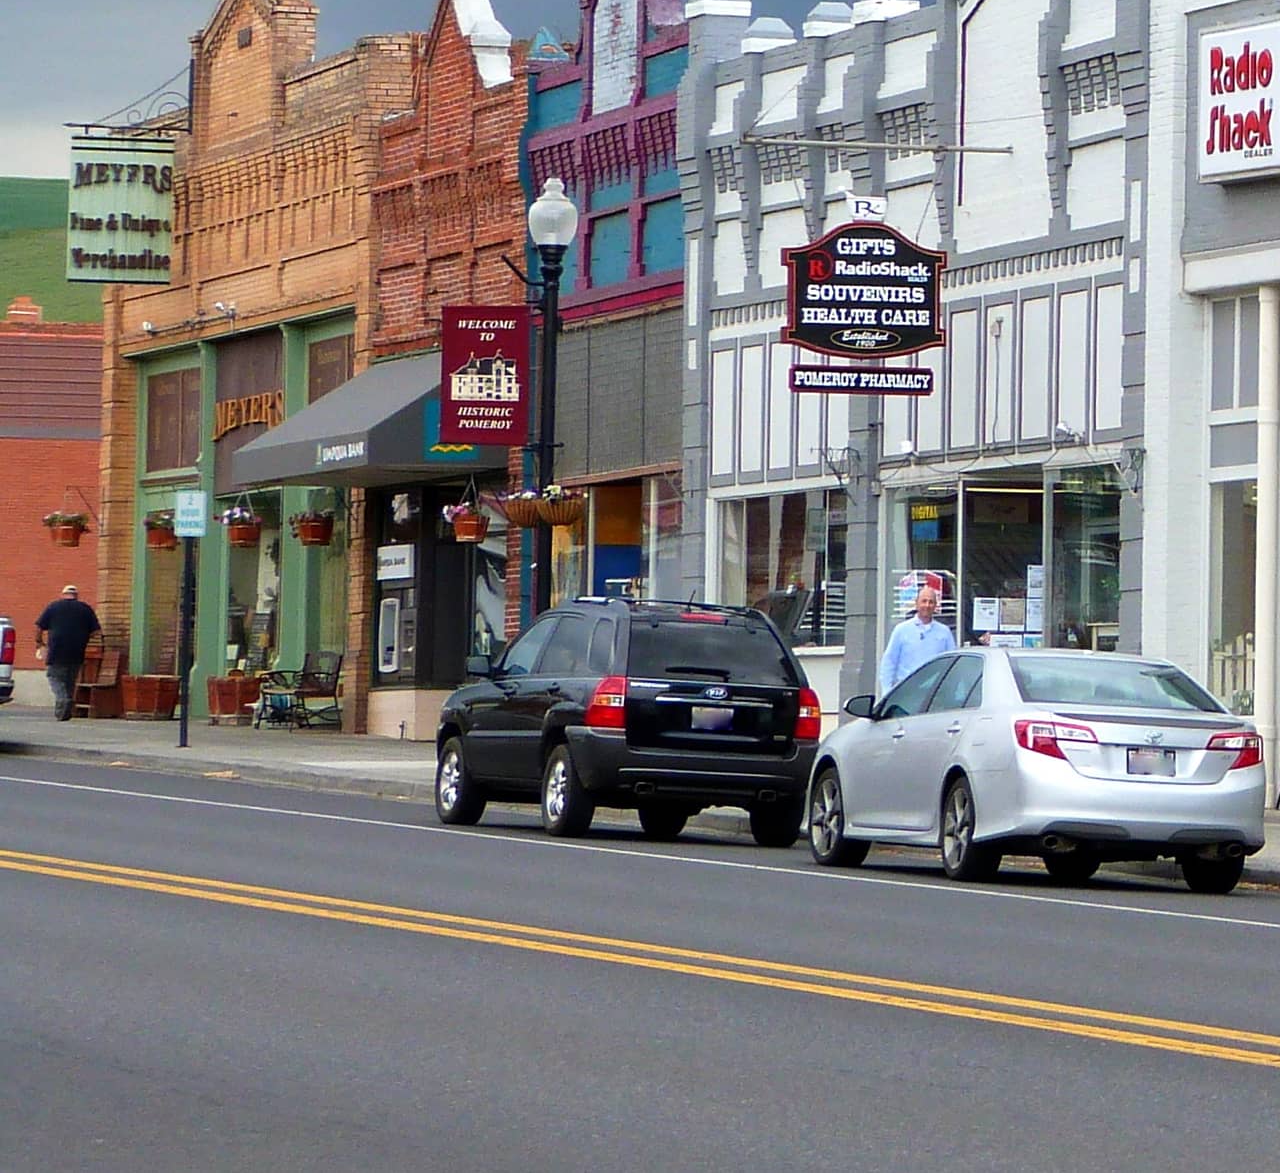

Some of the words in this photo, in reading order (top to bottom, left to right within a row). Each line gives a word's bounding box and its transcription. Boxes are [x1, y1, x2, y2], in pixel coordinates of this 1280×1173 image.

[1210, 41, 1273, 95] Radio
[1206, 98, 1272, 155] Shack
[106, 213, 118, 231] &
[836, 238, 895, 255] GIFTS
[807, 285, 925, 303] SOUVENIRS
[457, 319, 517, 330] WELCOME
[802, 308, 876, 324] HEALTH
[881, 310, 930, 326] CARE
[479, 331, 495, 342] TO
[794, 371, 857, 386] POMEROY
[860, 373, 931, 388] PHARMACY
[213, 389, 288, 442] MEYERS
[457, 407, 514, 417] HISTORIC
[458, 419, 513, 430] POMEROY
